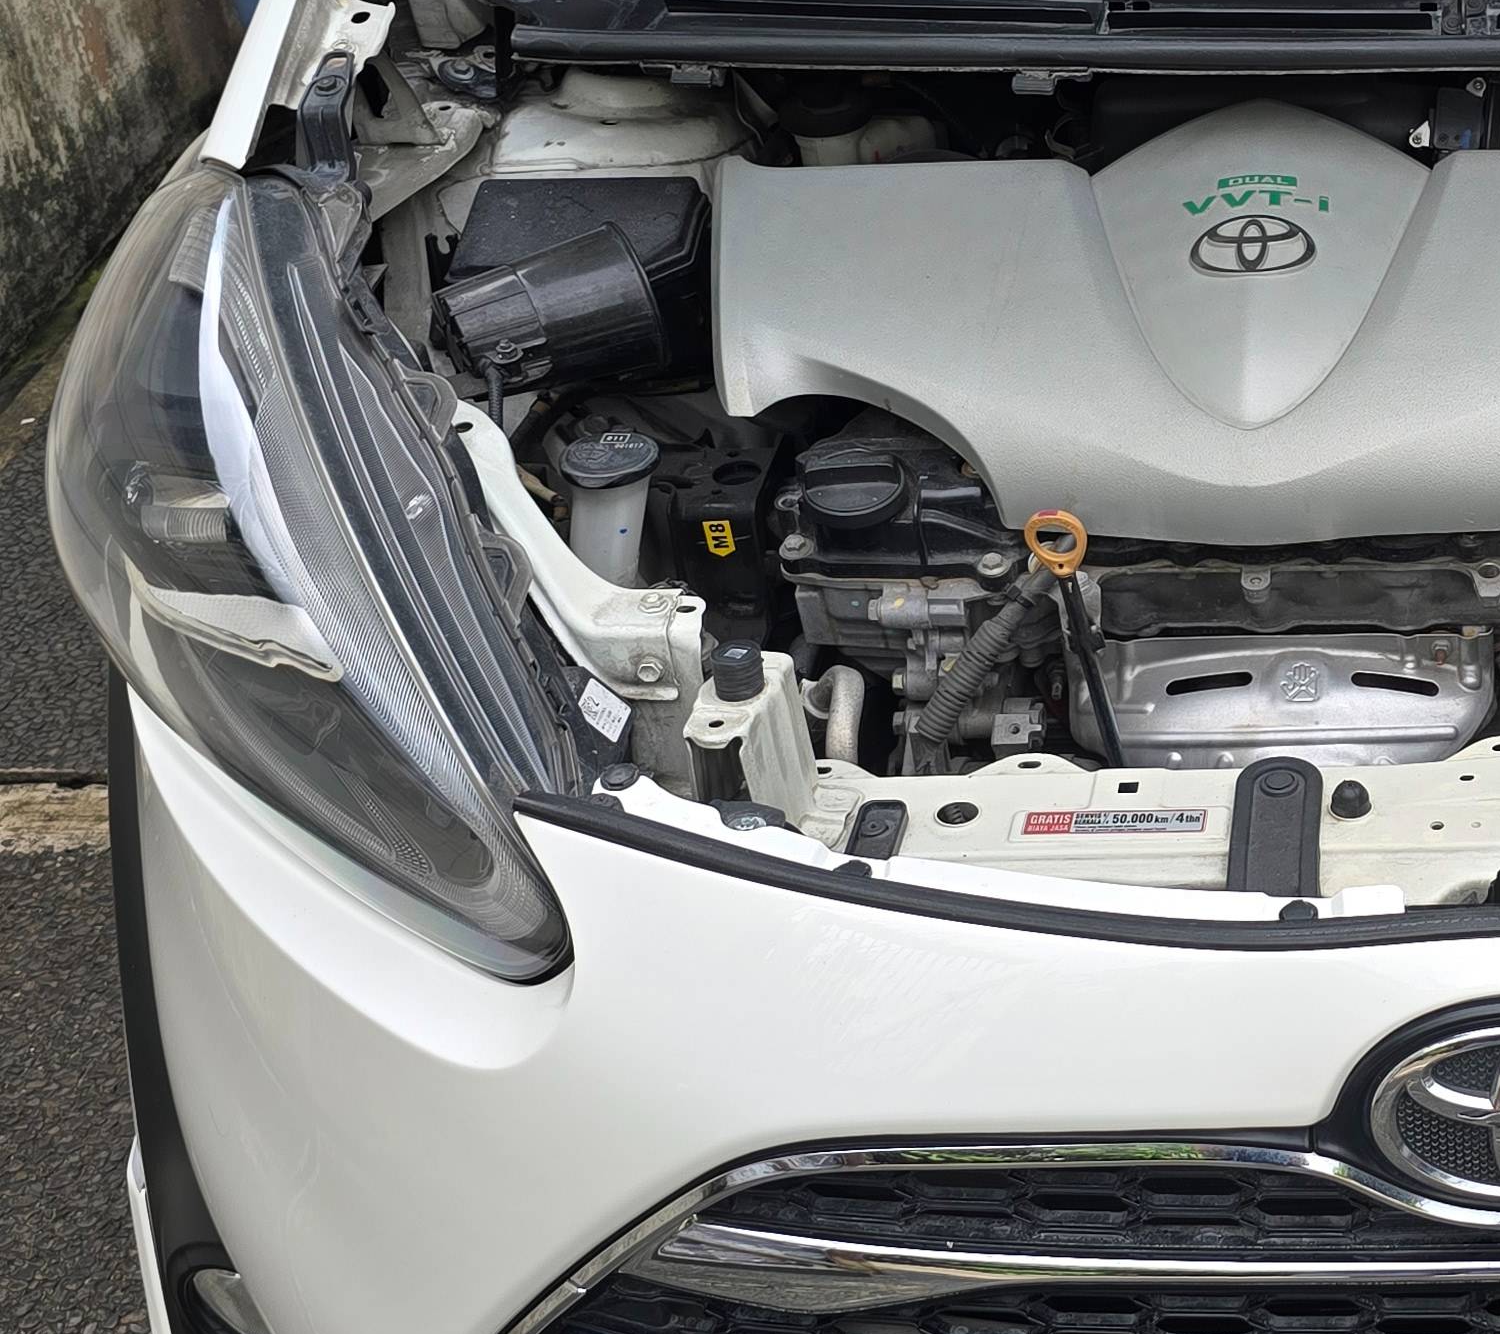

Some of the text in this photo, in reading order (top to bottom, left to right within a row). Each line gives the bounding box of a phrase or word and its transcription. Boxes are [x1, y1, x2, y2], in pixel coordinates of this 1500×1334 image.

[1228, 176, 1290, 185] DUAL
[1182, 190, 1330, 216] VVT-i
[709, 523, 730, 549] M8
[1030, 813, 1072, 825] GRATIS
[1112, 812, 1154, 824] 50.000
